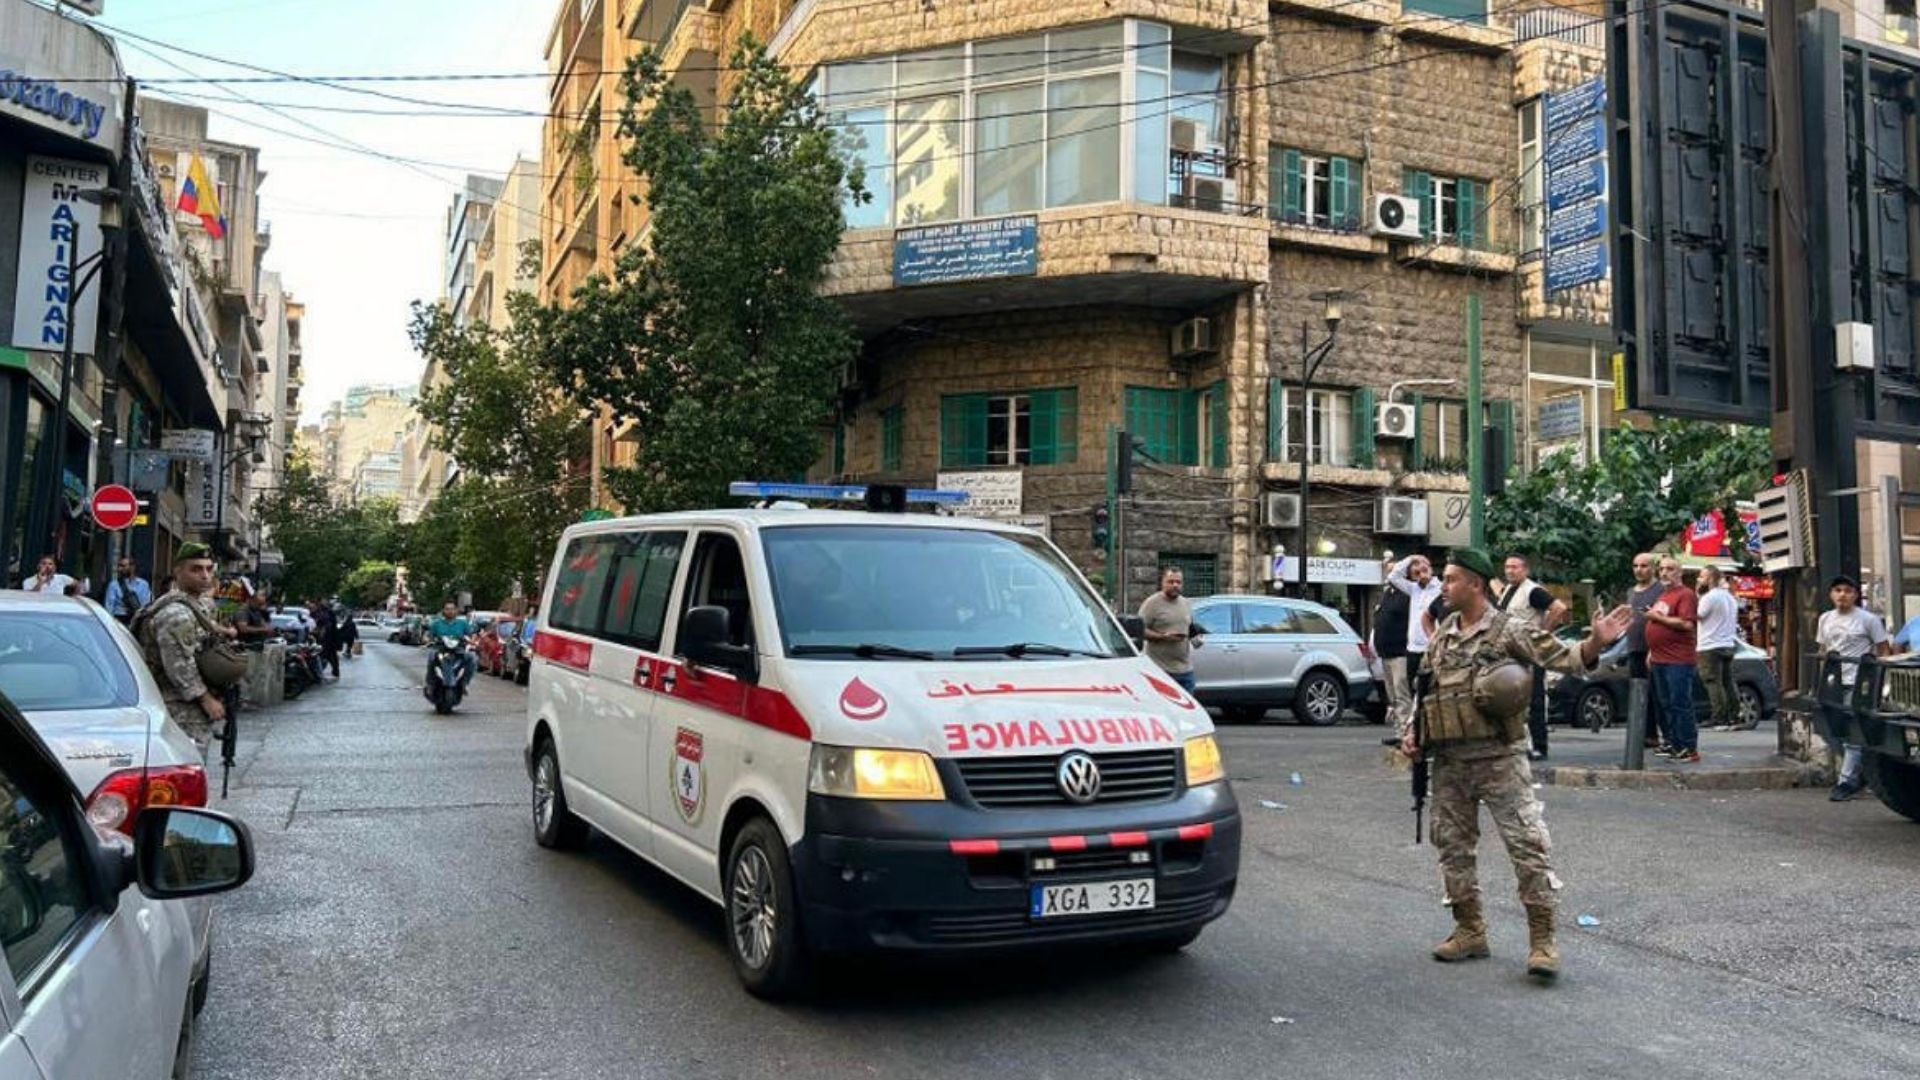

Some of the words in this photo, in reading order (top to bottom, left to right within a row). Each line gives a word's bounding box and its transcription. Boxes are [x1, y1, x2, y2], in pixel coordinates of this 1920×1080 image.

[33, 161, 100, 182] CENTER
[41, 182, 79, 344] MARIGNAN
[927, 680, 1140, 702] إسعاف
[1046, 886, 1090, 912] XGA
[1108, 882, 1150, 907] 332
